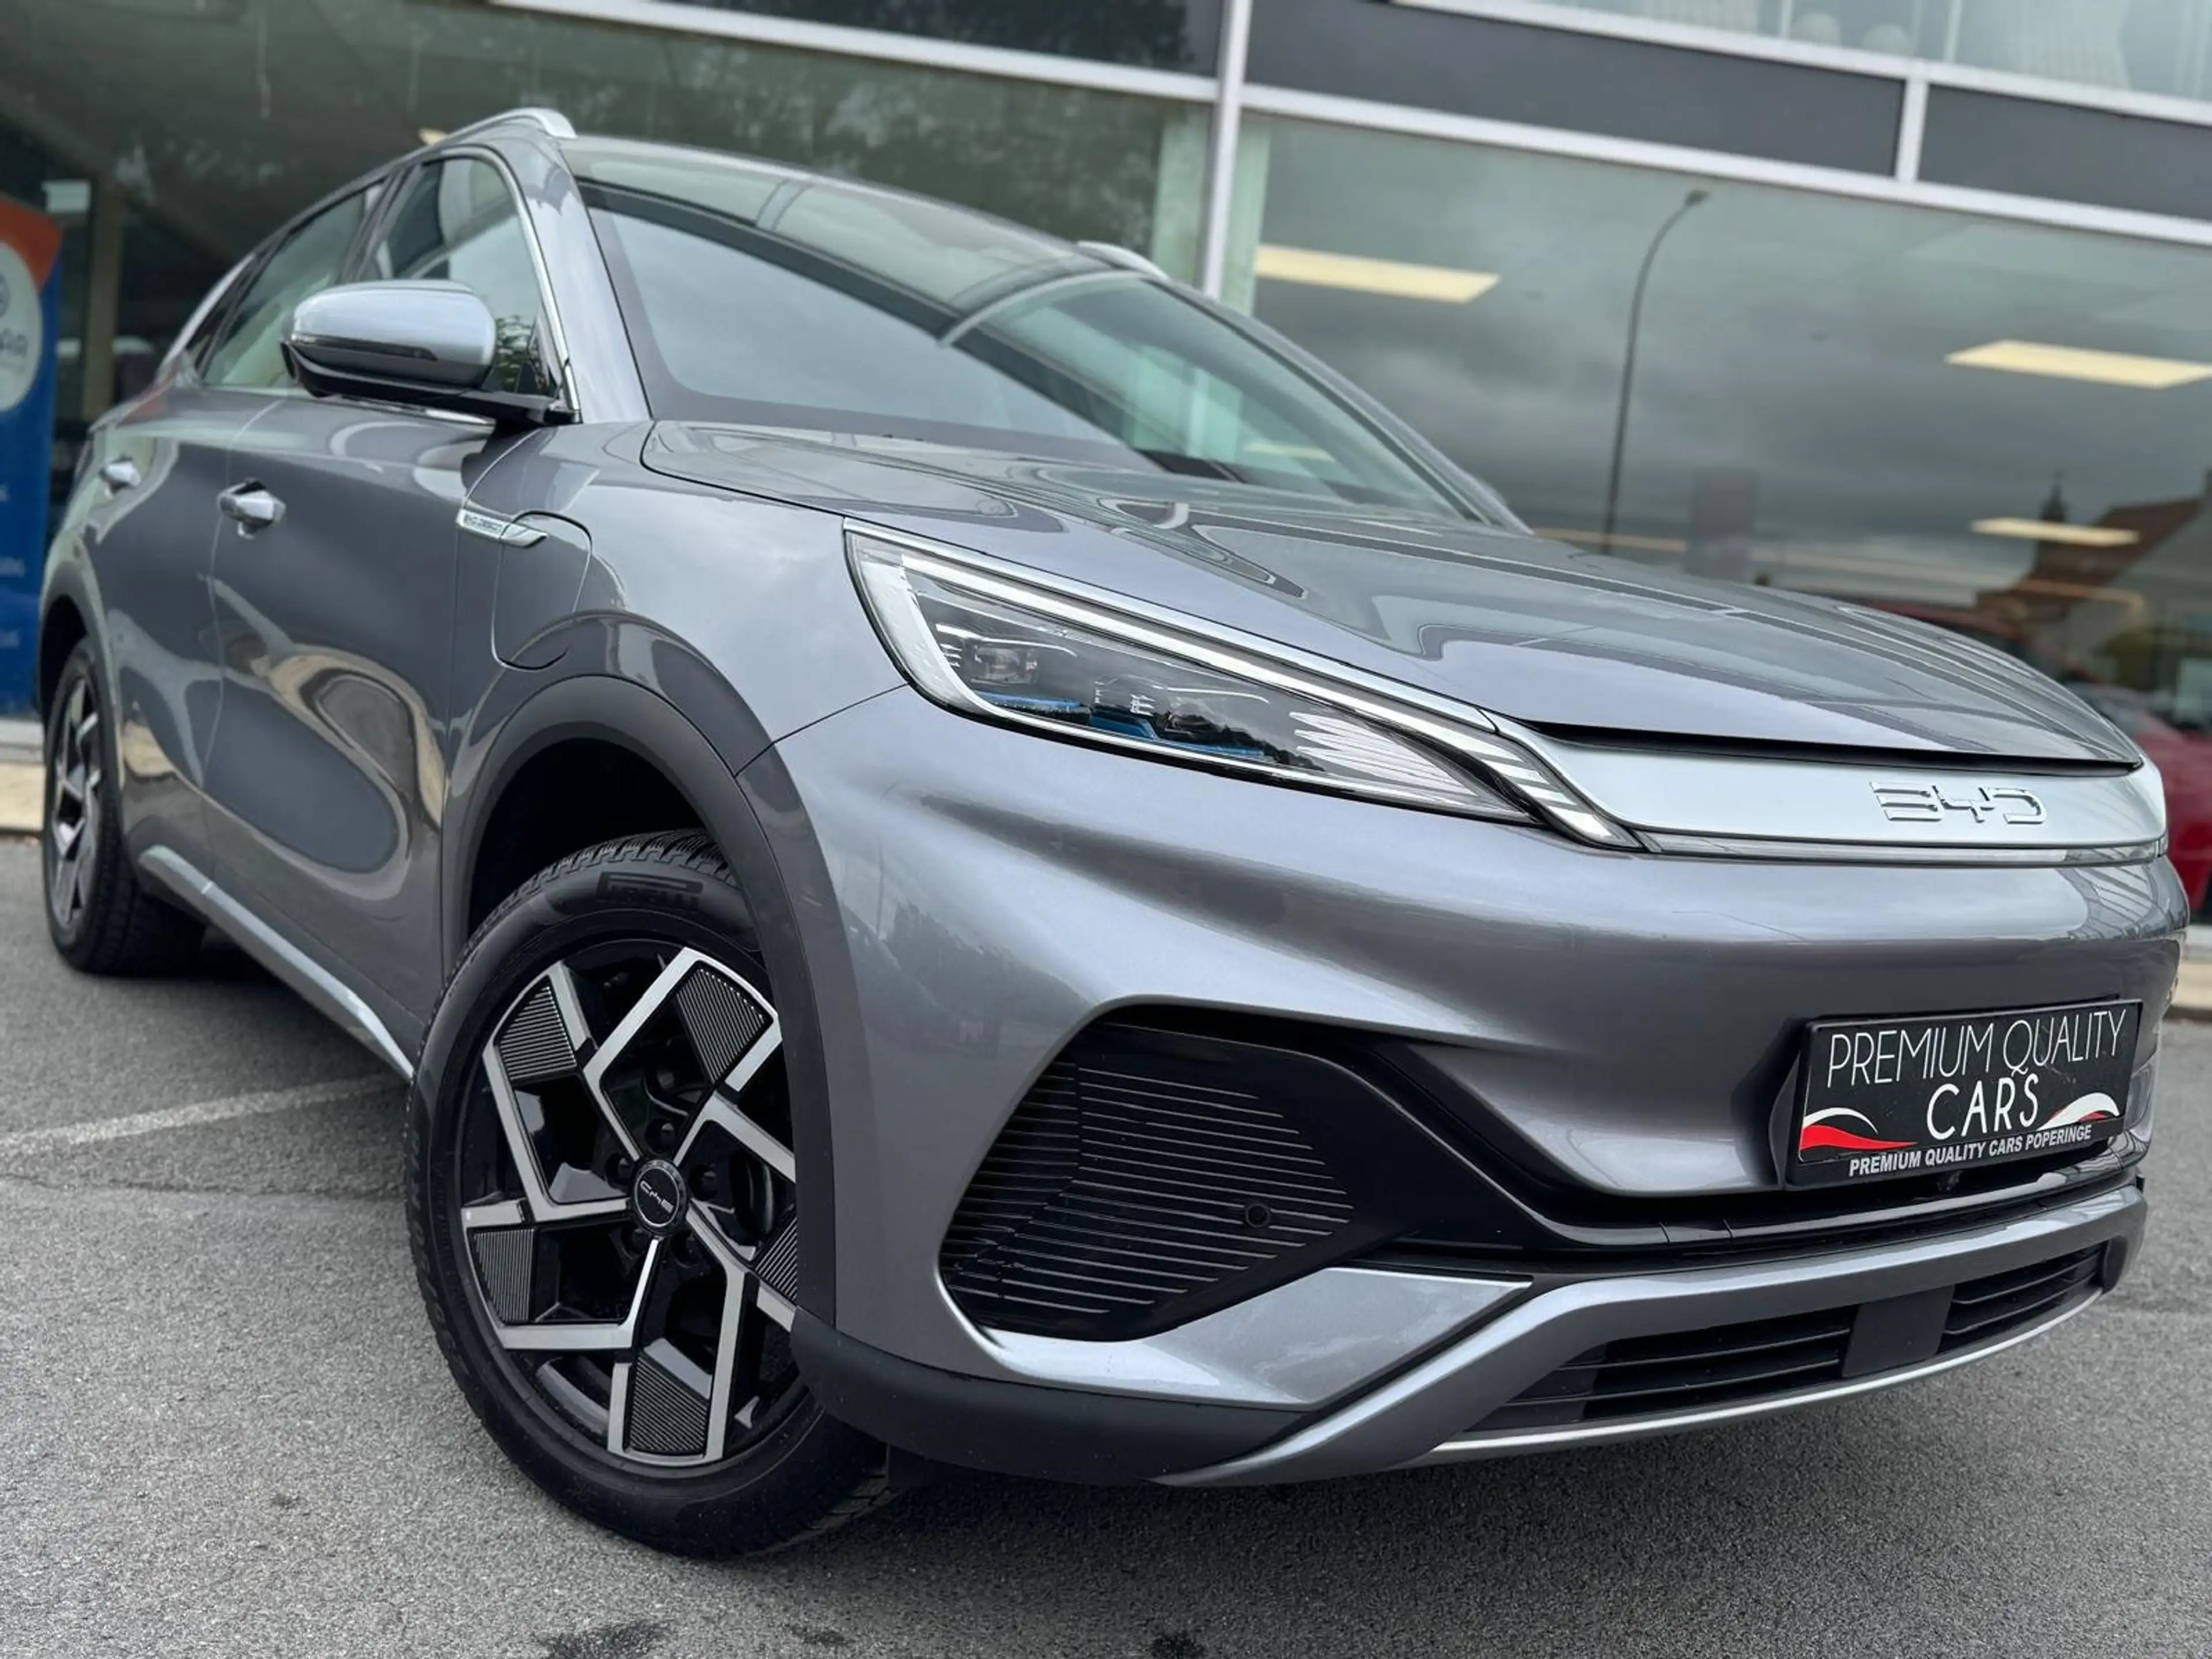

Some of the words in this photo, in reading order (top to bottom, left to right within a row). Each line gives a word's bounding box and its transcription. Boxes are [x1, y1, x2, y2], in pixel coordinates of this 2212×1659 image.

[1869, 781, 2046, 824] BYD
[1827, 1022, 1994, 1088] PREMIUM
[2003, 1009, 2127, 1077] QUALITY
[1926, 1073, 2039, 1140] CARS
[1849, 1151, 1922, 1177] PREMIUM
[1925, 1142, 1986, 1166] QUALITY
[1988, 1135, 2023, 1157] CARS
[2025, 1124, 2092, 1151] POPERINGE
